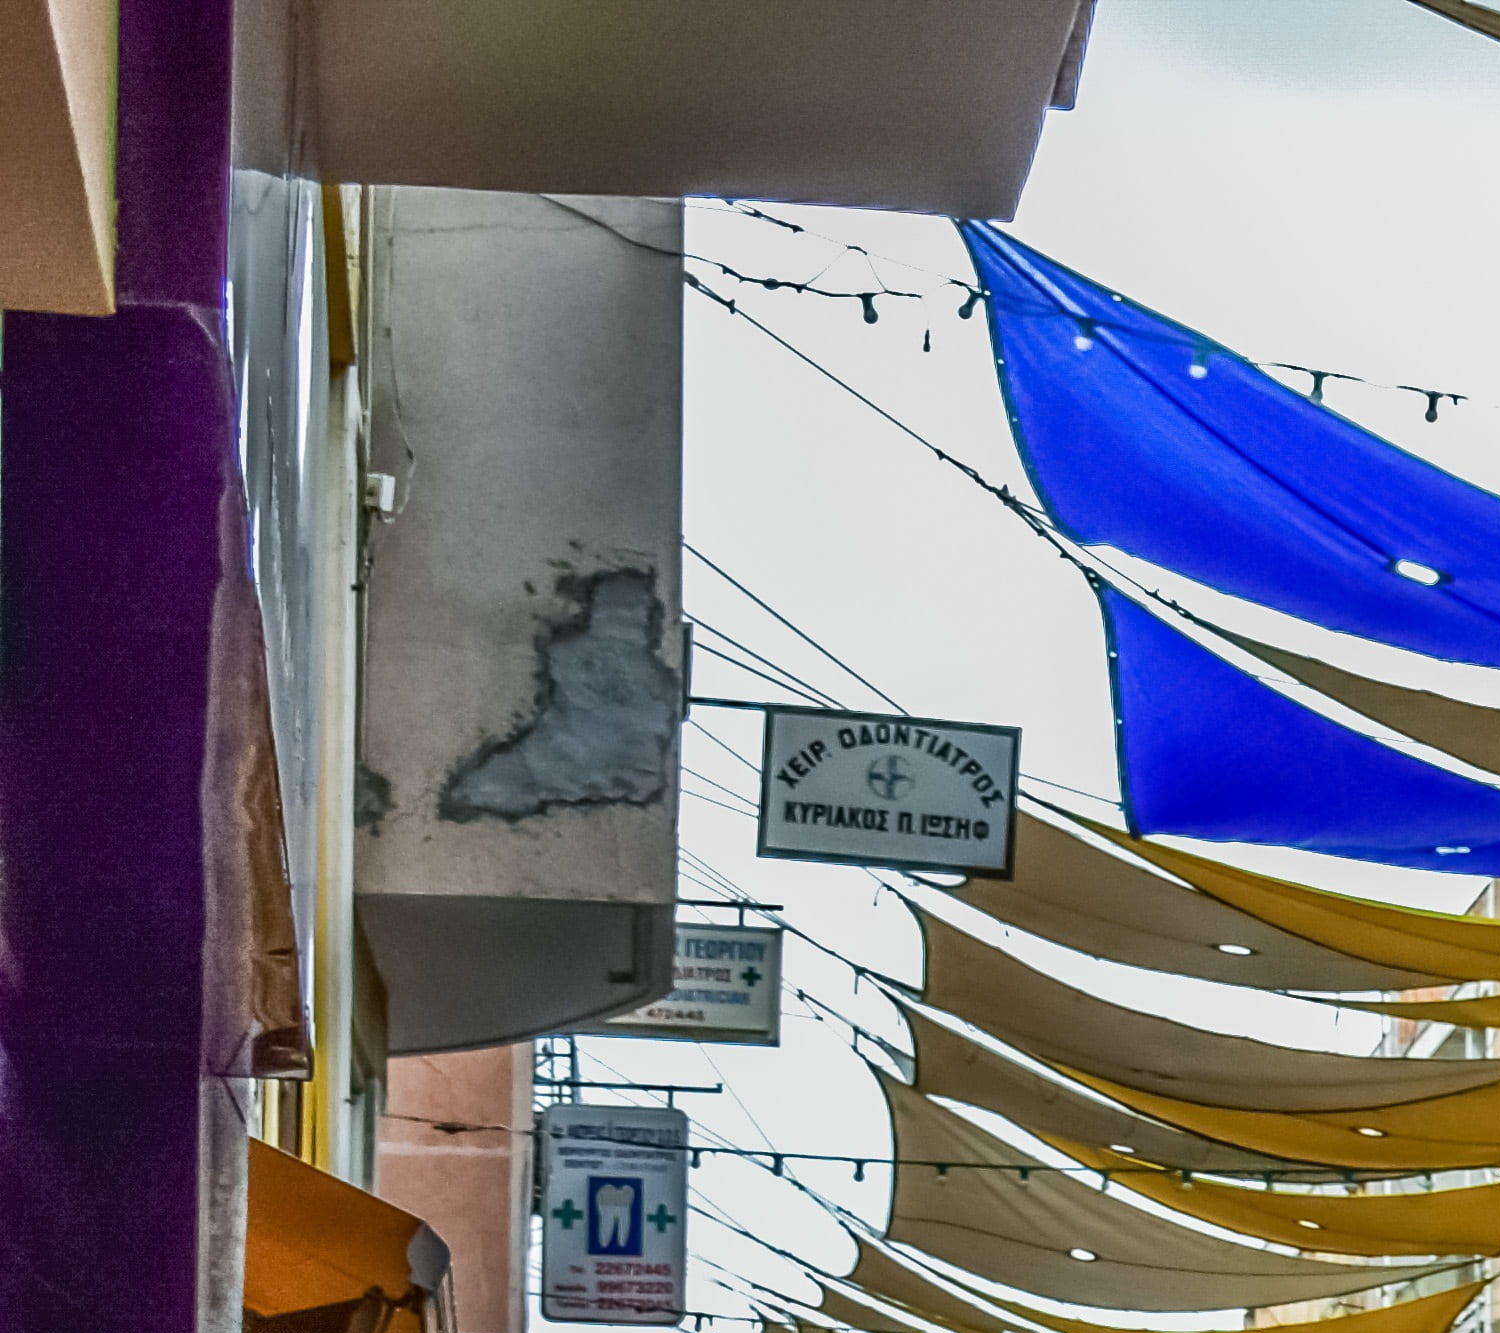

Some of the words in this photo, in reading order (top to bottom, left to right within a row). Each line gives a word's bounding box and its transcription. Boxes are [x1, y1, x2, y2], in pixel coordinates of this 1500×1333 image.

[838, 724, 1004, 808] ΟΔΟΝΤΙΑΤΡΟΣ
[785, 801, 889, 832] ΚΥΡΙΑΚΟΣ
[921, 814, 990, 841] ΙΩΣΗΦ
